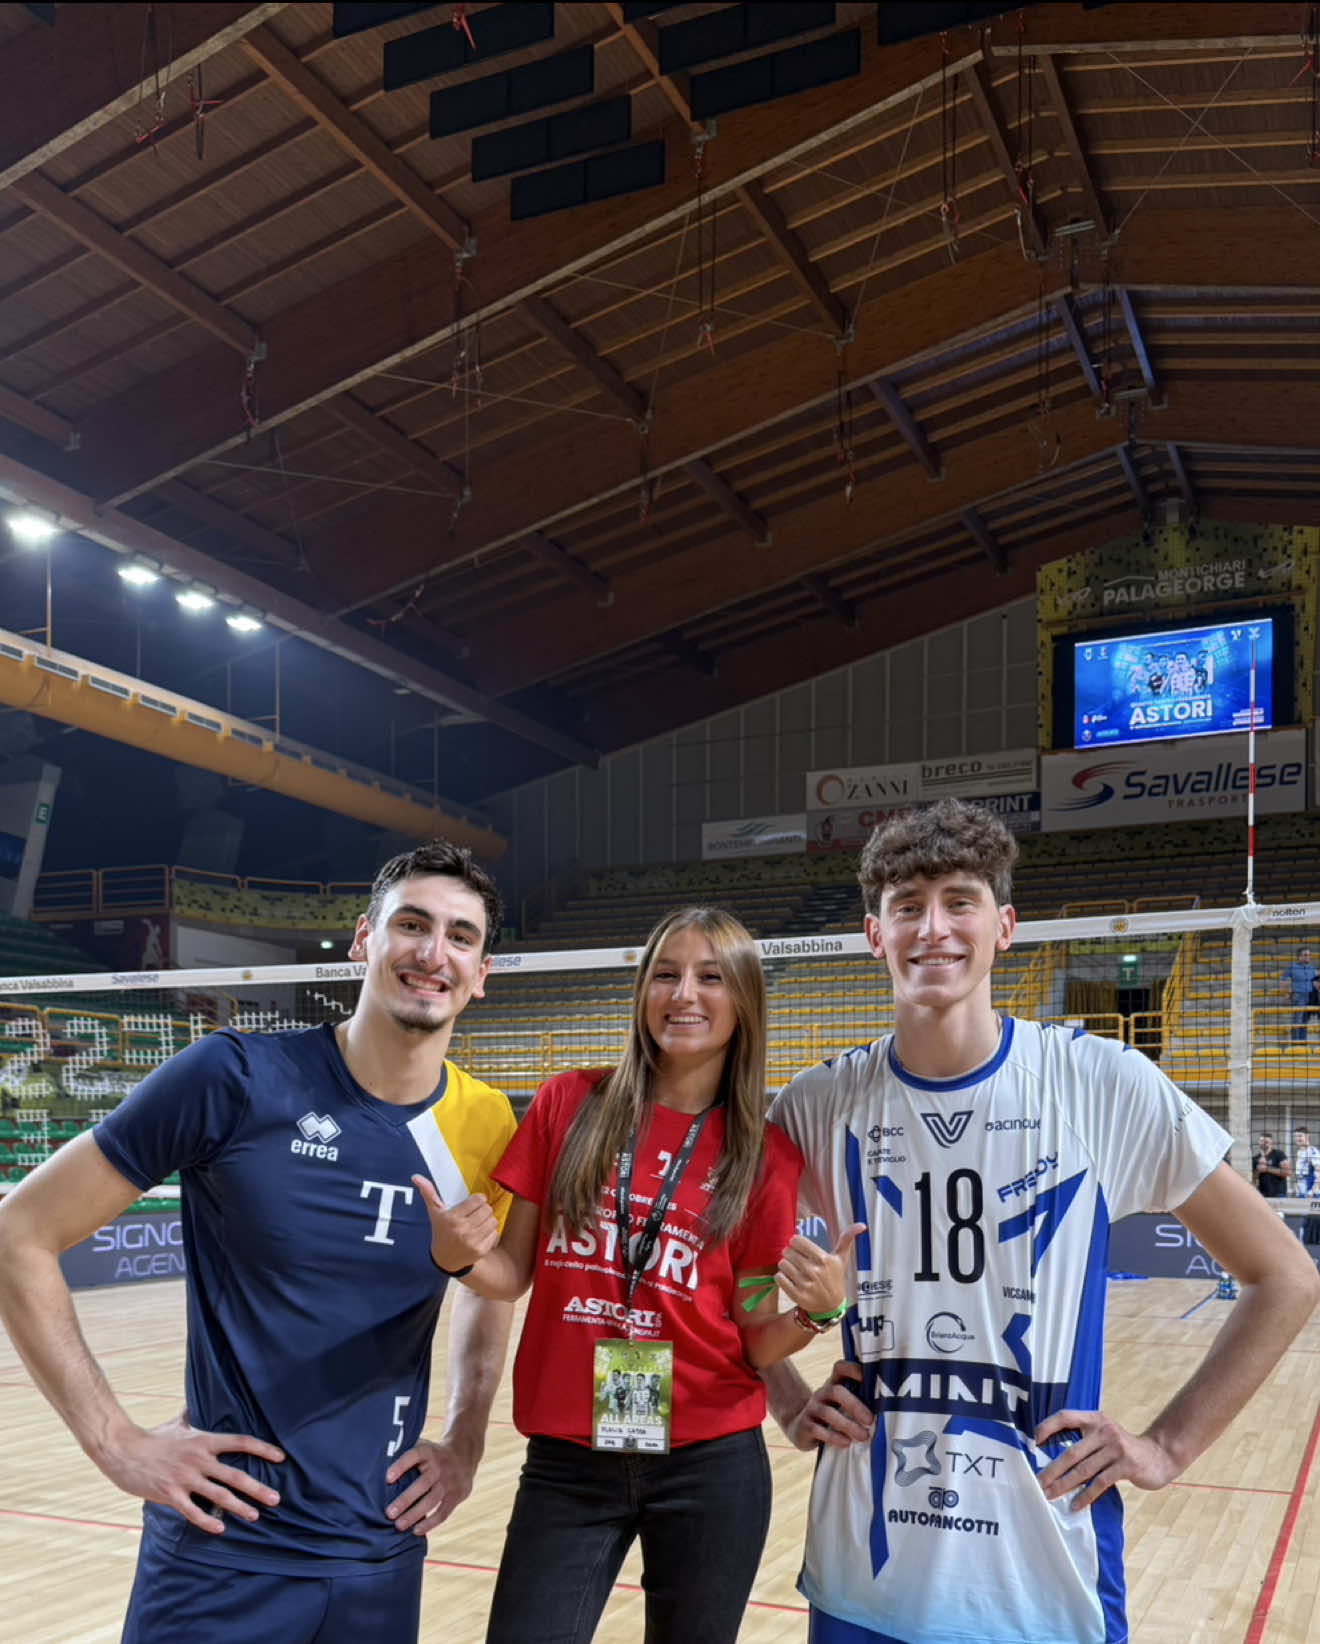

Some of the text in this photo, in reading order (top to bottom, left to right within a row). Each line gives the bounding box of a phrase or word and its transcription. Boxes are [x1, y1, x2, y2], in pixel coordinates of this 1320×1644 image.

[1158, 560, 1246, 580] MONTICHIARI
[1103, 571, 1246, 606] PALAGEORGE
[1129, 699, 1213, 724] ASTORI
[921, 760, 982, 779] breco
[1122, 762, 1303, 800] Savallese
[1168, 794, 1249, 809] TRASPORT
[761, 939, 842, 956] Valsabbina
[315, 965, 351, 979] Banca
[359, 1180, 414, 1246] T
[914, 1168, 986, 1284] 18
[545, 1214, 699, 1291] ASTORI
[874, 1373, 1030, 1412] MINT
[386, 1395, 412, 1457] 5
[945, 1450, 1005, 1478] TXT
[888, 1509, 999, 1536] AUTOFANCOTTI
